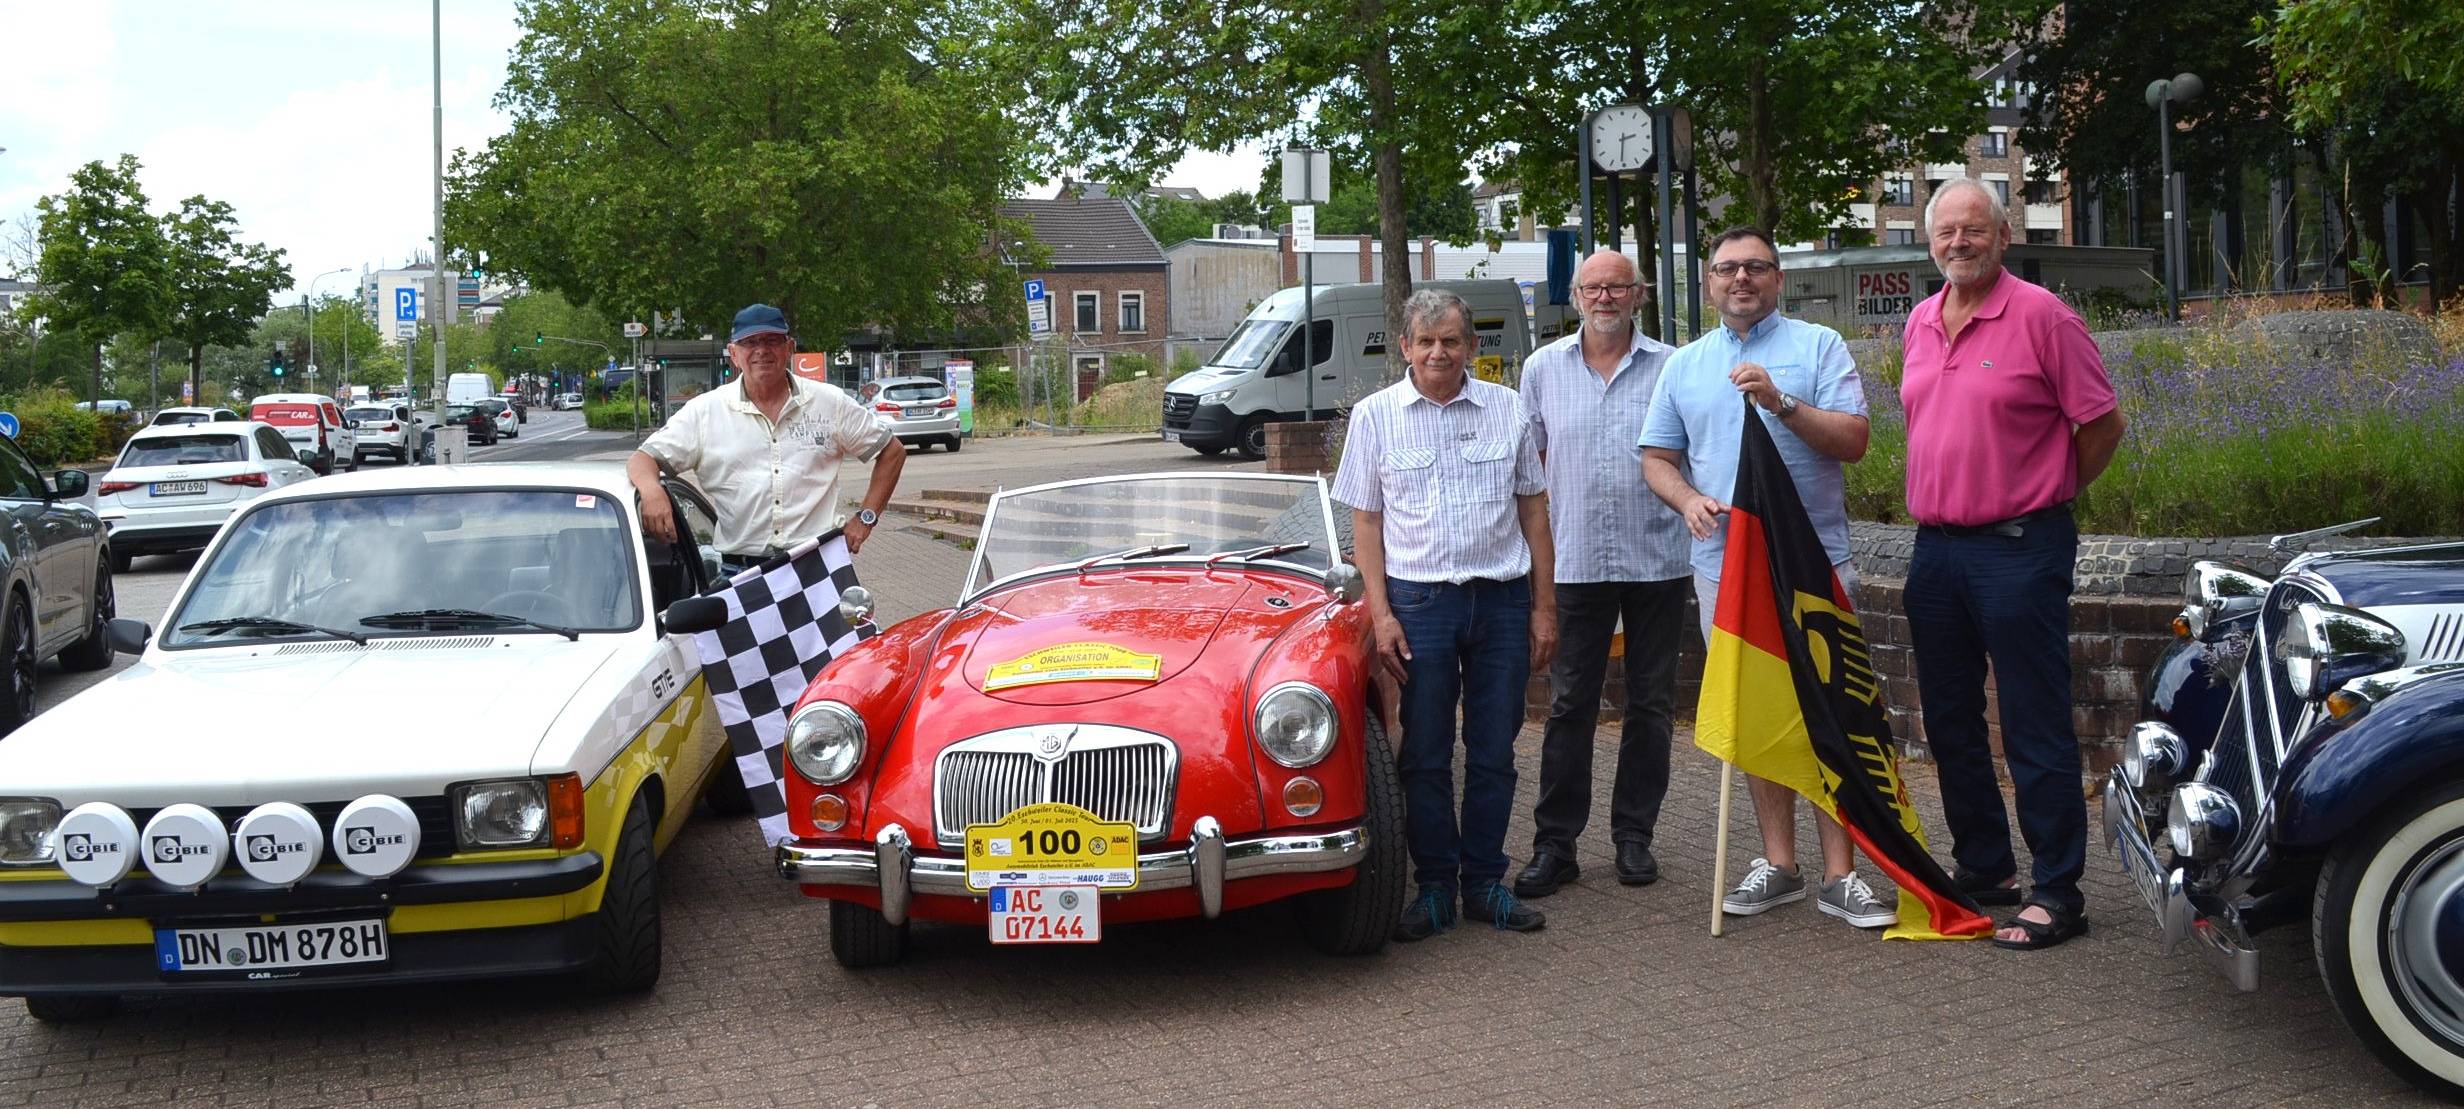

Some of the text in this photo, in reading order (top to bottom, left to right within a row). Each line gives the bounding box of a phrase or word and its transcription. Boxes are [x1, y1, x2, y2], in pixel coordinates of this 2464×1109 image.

[1028, 283, 1040, 299] P
[1858, 271, 1911, 297] PASS
[400, 291, 412, 317] P
[1857, 296, 1913, 316] BILDER
[156, 484, 168, 493] AC
[1039, 652, 1110, 665] ORGANISATION
[1019, 829, 1081, 855] 100
[1111, 835, 1129, 843] ADAC
[1078, 874, 1105, 883] HAUGG
[1011, 889, 1043, 913] AC
[1005, 915, 1084, 940] 07144
[178, 932, 222, 965] DN
[245, 930, 290, 964] DM
[296, 924, 383, 961] 878H
